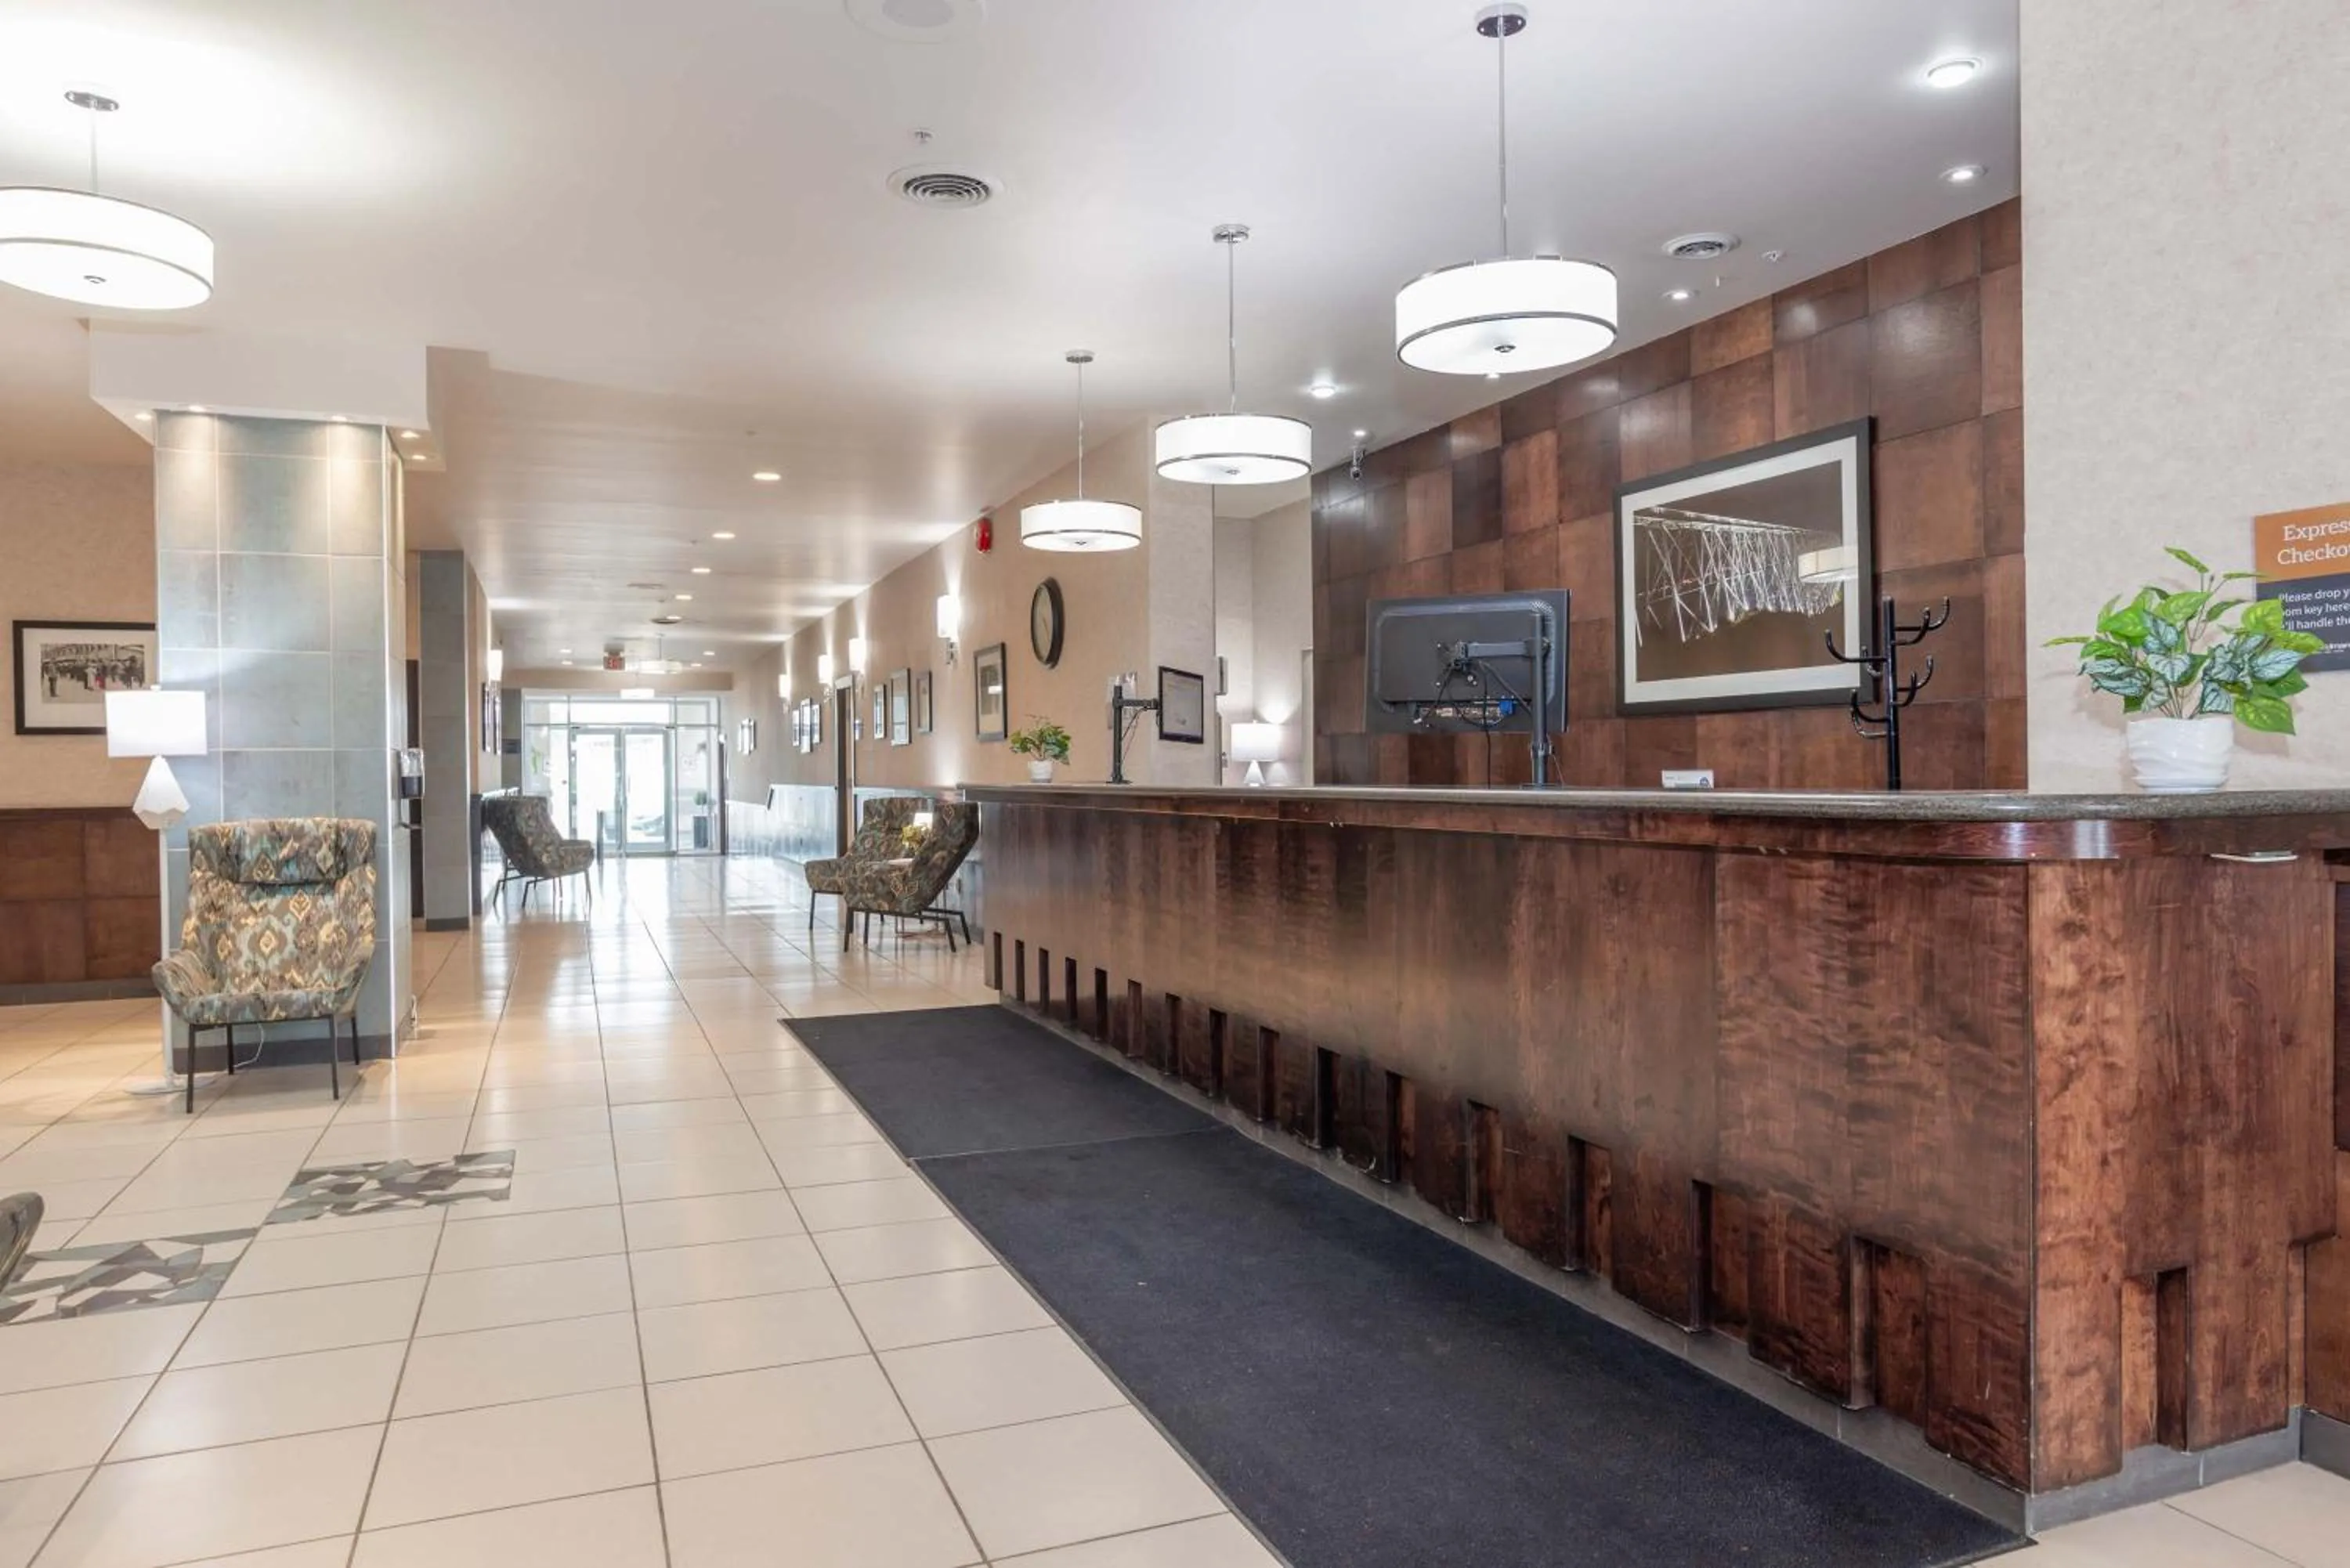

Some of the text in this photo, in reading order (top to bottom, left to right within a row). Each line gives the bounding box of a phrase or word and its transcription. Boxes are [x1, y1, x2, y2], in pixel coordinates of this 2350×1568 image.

[2277, 544, 2350, 564] Checko
[2315, 588, 2341, 599] drop
[2304, 605, 2323, 616] key
[2296, 616, 2334, 630] handle
